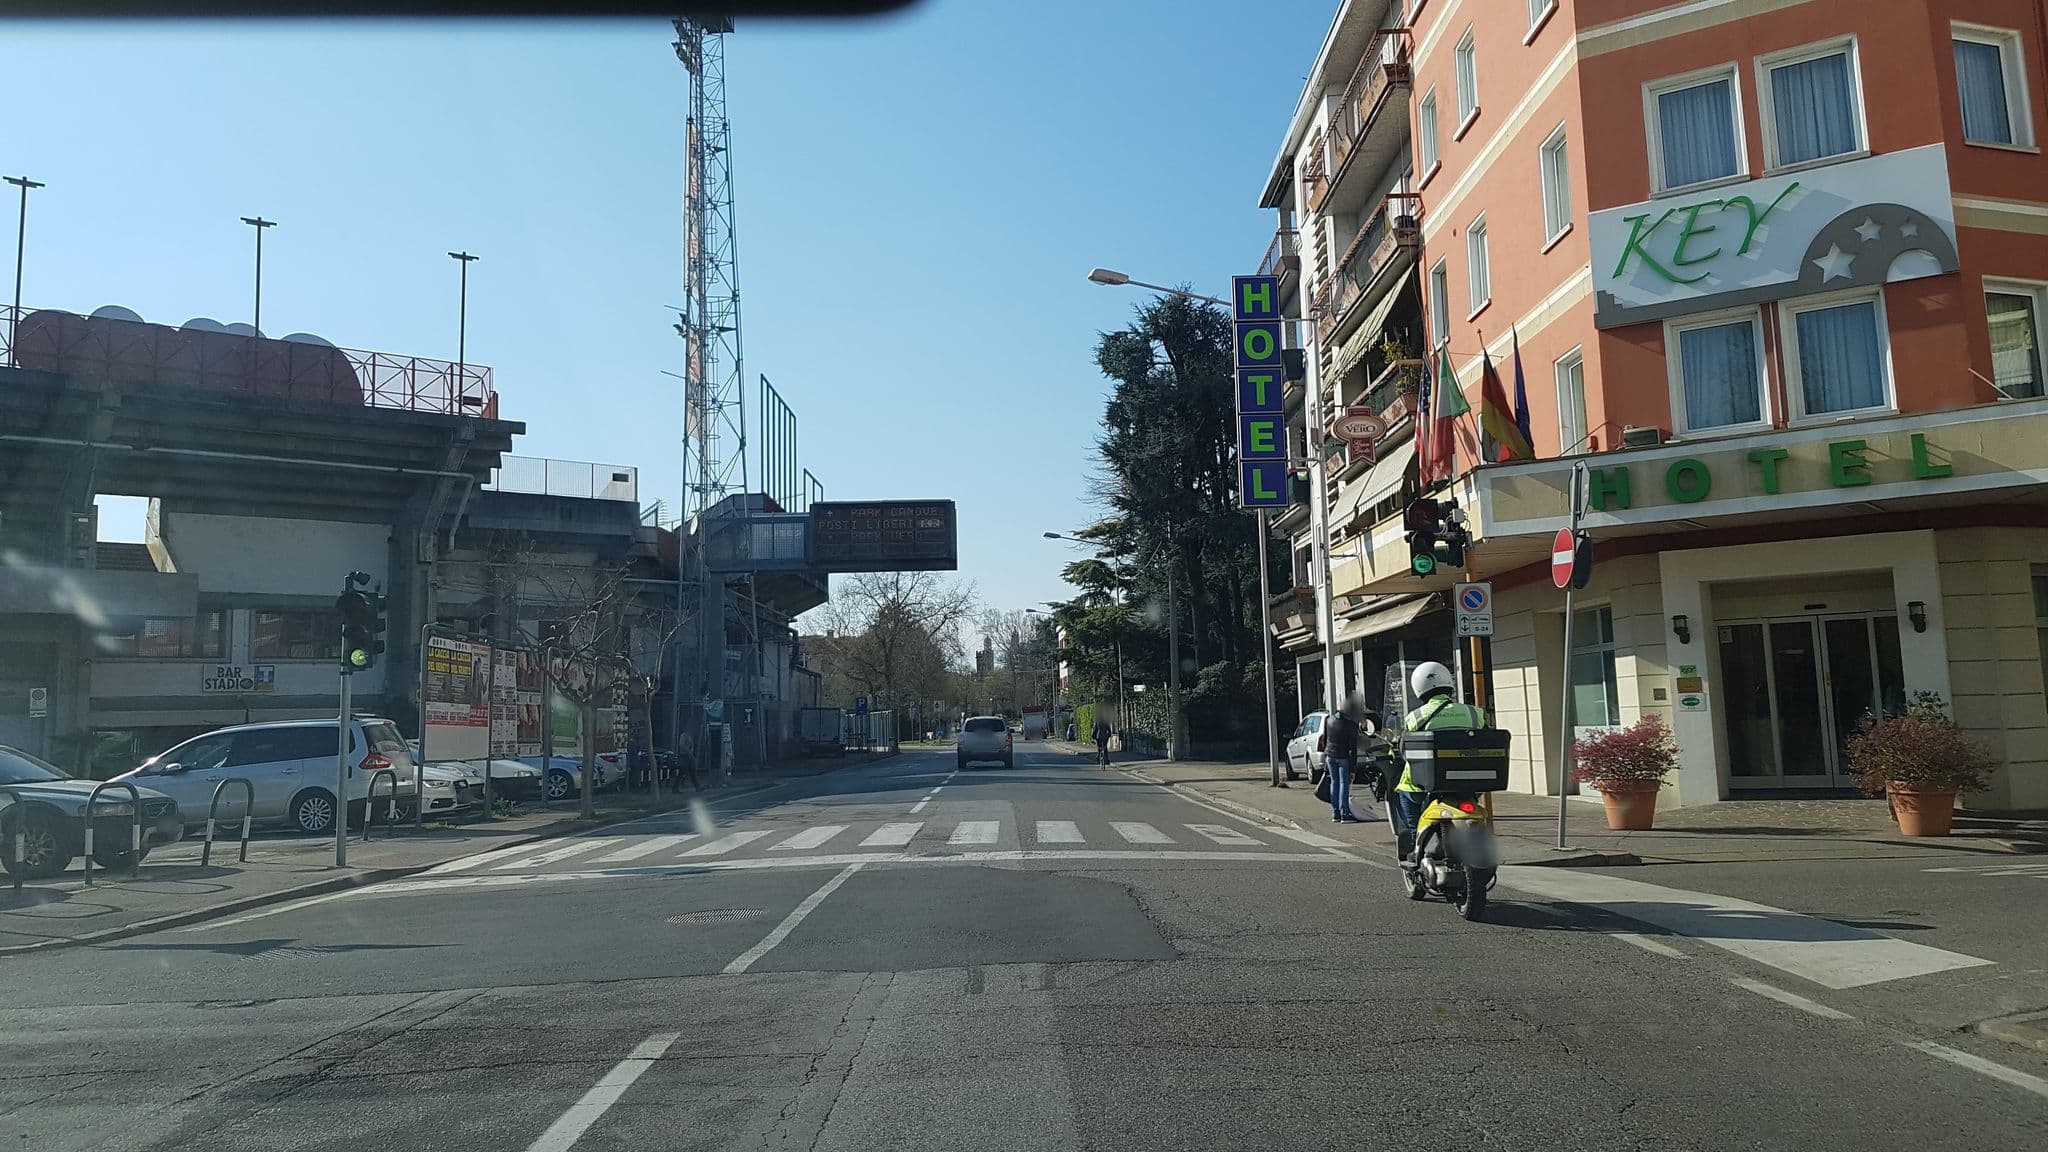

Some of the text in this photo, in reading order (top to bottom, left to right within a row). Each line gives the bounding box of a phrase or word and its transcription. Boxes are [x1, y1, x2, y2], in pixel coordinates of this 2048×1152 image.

[1612, 182, 1799, 284] KEY
[1242, 283, 1277, 499] HOTEL
[1345, 425, 1376, 433] VERO
[1590, 432, 1953, 510] HOTEL
[850, 508, 881, 517] PARK
[818, 520, 858, 530] POSTI
[866, 519, 914, 529] LIBERI
[217, 666, 242, 678] BAR
[205, 678, 254, 690] STADIO
